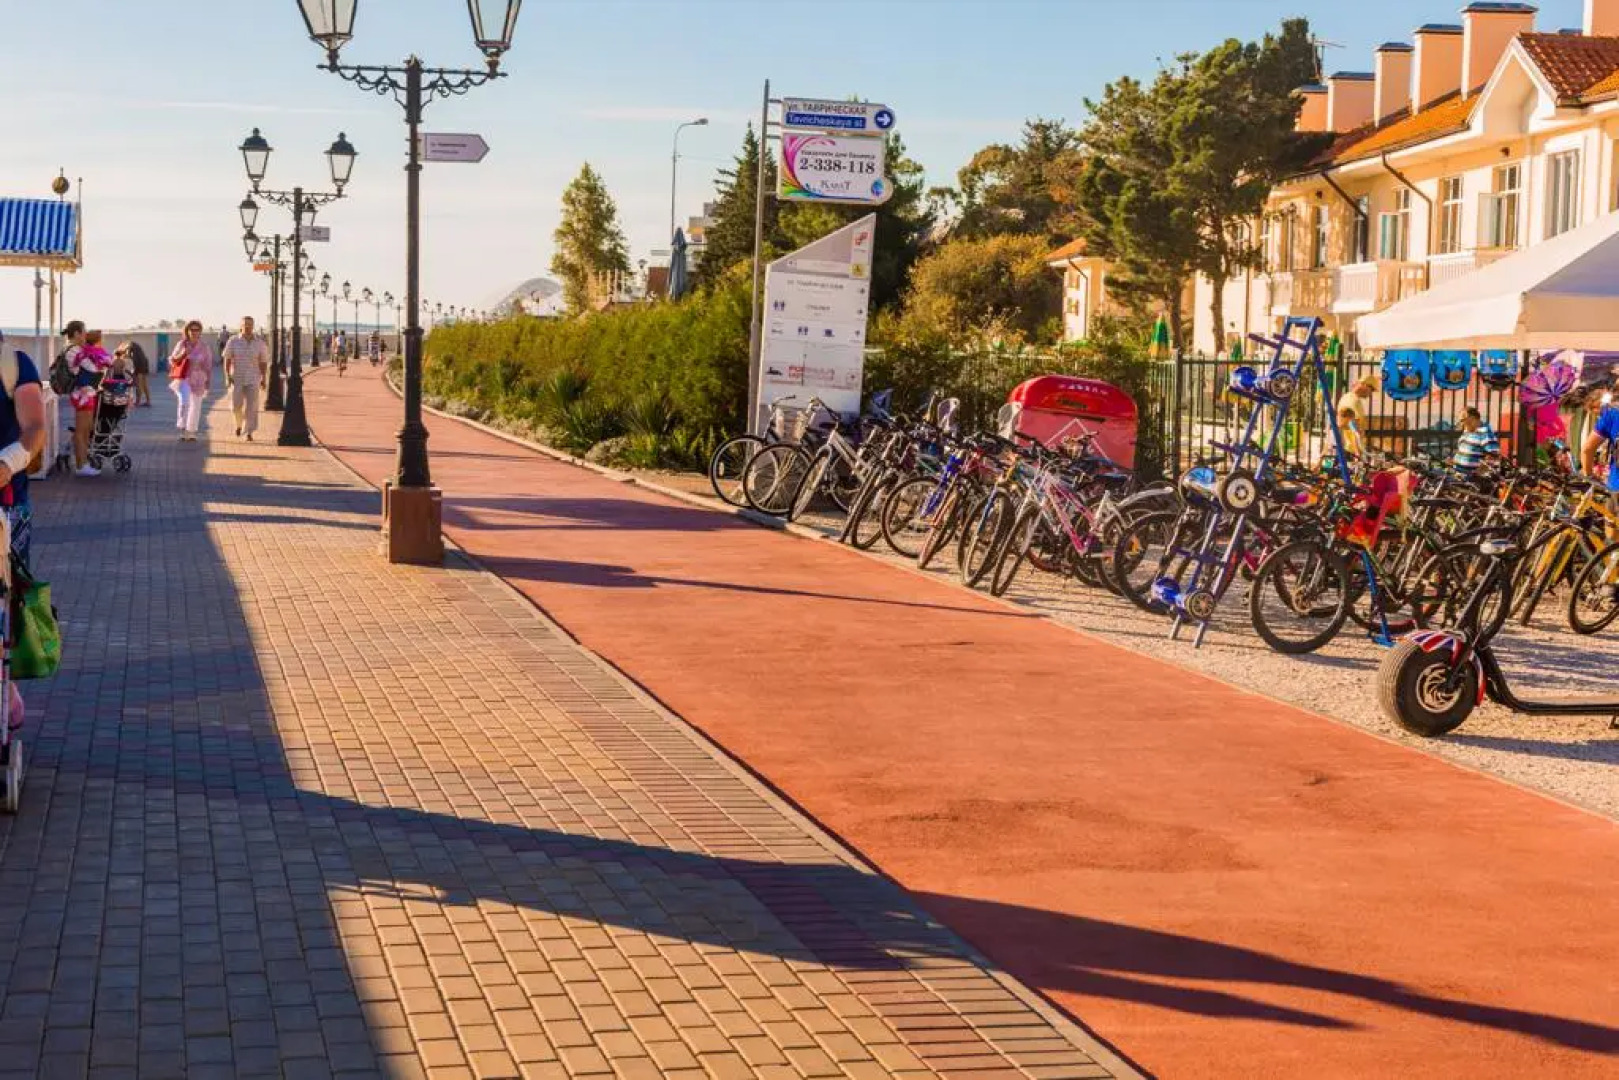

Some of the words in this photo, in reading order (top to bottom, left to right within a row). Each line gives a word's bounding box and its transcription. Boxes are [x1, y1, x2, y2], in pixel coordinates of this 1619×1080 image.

[802, 103, 867, 114] ТАВРИЧЕСКАЯ
[789, 113, 852, 126] Tavricheskaya
[799, 158, 876, 174] 2-338-118
